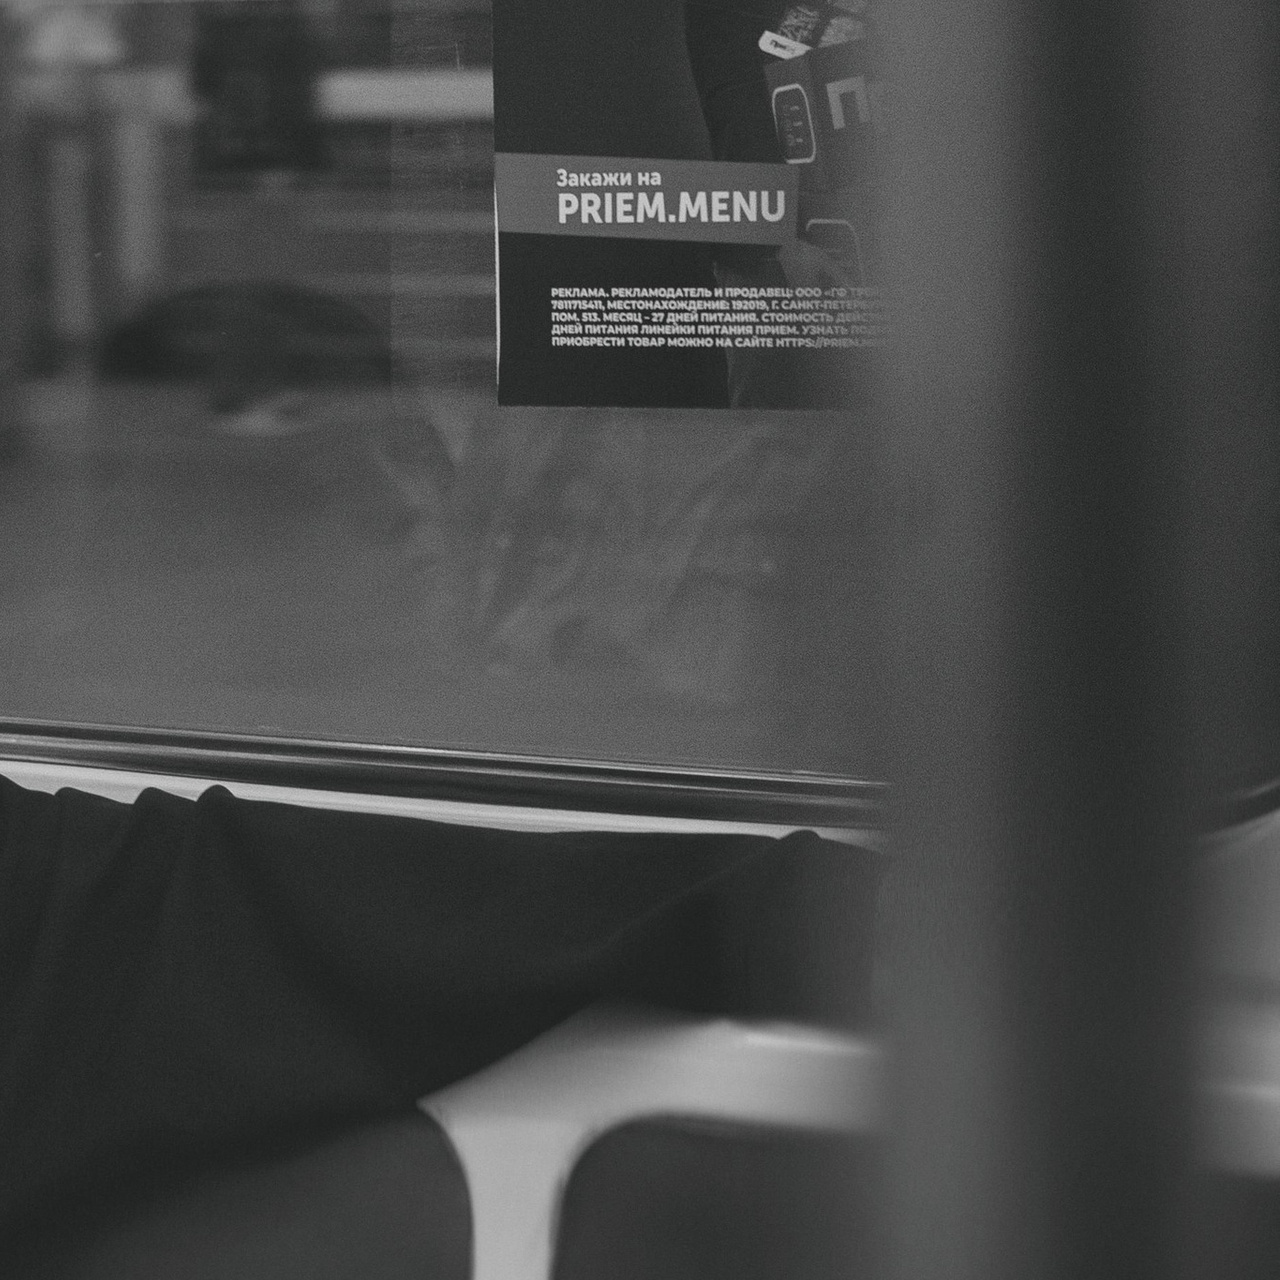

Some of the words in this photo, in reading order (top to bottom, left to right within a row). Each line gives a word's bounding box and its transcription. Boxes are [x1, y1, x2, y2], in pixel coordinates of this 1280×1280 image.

[556, 168, 632, 187] Закажи
[637, 171, 661, 186] на
[558, 190, 785, 224] PRIEM.MENU
[551, 287, 609, 298] РЕКЛАМА.
[611, 287, 712, 299] РЕКЛАМОДАТЕЛЬ
[714, 287, 723, 297] И
[725, 287, 794, 299] ПРОДАВЕЦ:
[795, 287, 821, 298] ООО
[607, 300, 730, 311] МЕСТОНАХОЖДЕНИЕ:
[781, 300, 870, 310] САНКТ-ПЕТЕР
[551, 312, 580, 322] ПОМ.
[603, 312, 642, 323] МЕСЯЦ
[651, 312, 664, 322] 27
[666, 310, 698, 323] ДНЕЙ
[701, 312, 759, 322] ПИТАНИЯ.
[761, 312, 833, 323] СТОИМОСТЬ
[551, 322, 583, 335] ДНЕЙ
[585, 324, 638, 334] ПИТАНИЯ
[640, 322, 696, 335] ЛИНЕЙКИ
[698, 325, 753, 335] ПИТАНИЯ
[755, 325, 799, 335] ПРИЕМ.
[801, 325, 848, 335] УЗНАТЬ
[551, 337, 625, 347] ПРИОБРЕСТИ
[627, 337, 665, 347] ТОВАР
[667, 337, 714, 347] МОЖНО
[716, 337, 732, 347] НА
[734, 335, 773, 347] САЙТЕ
